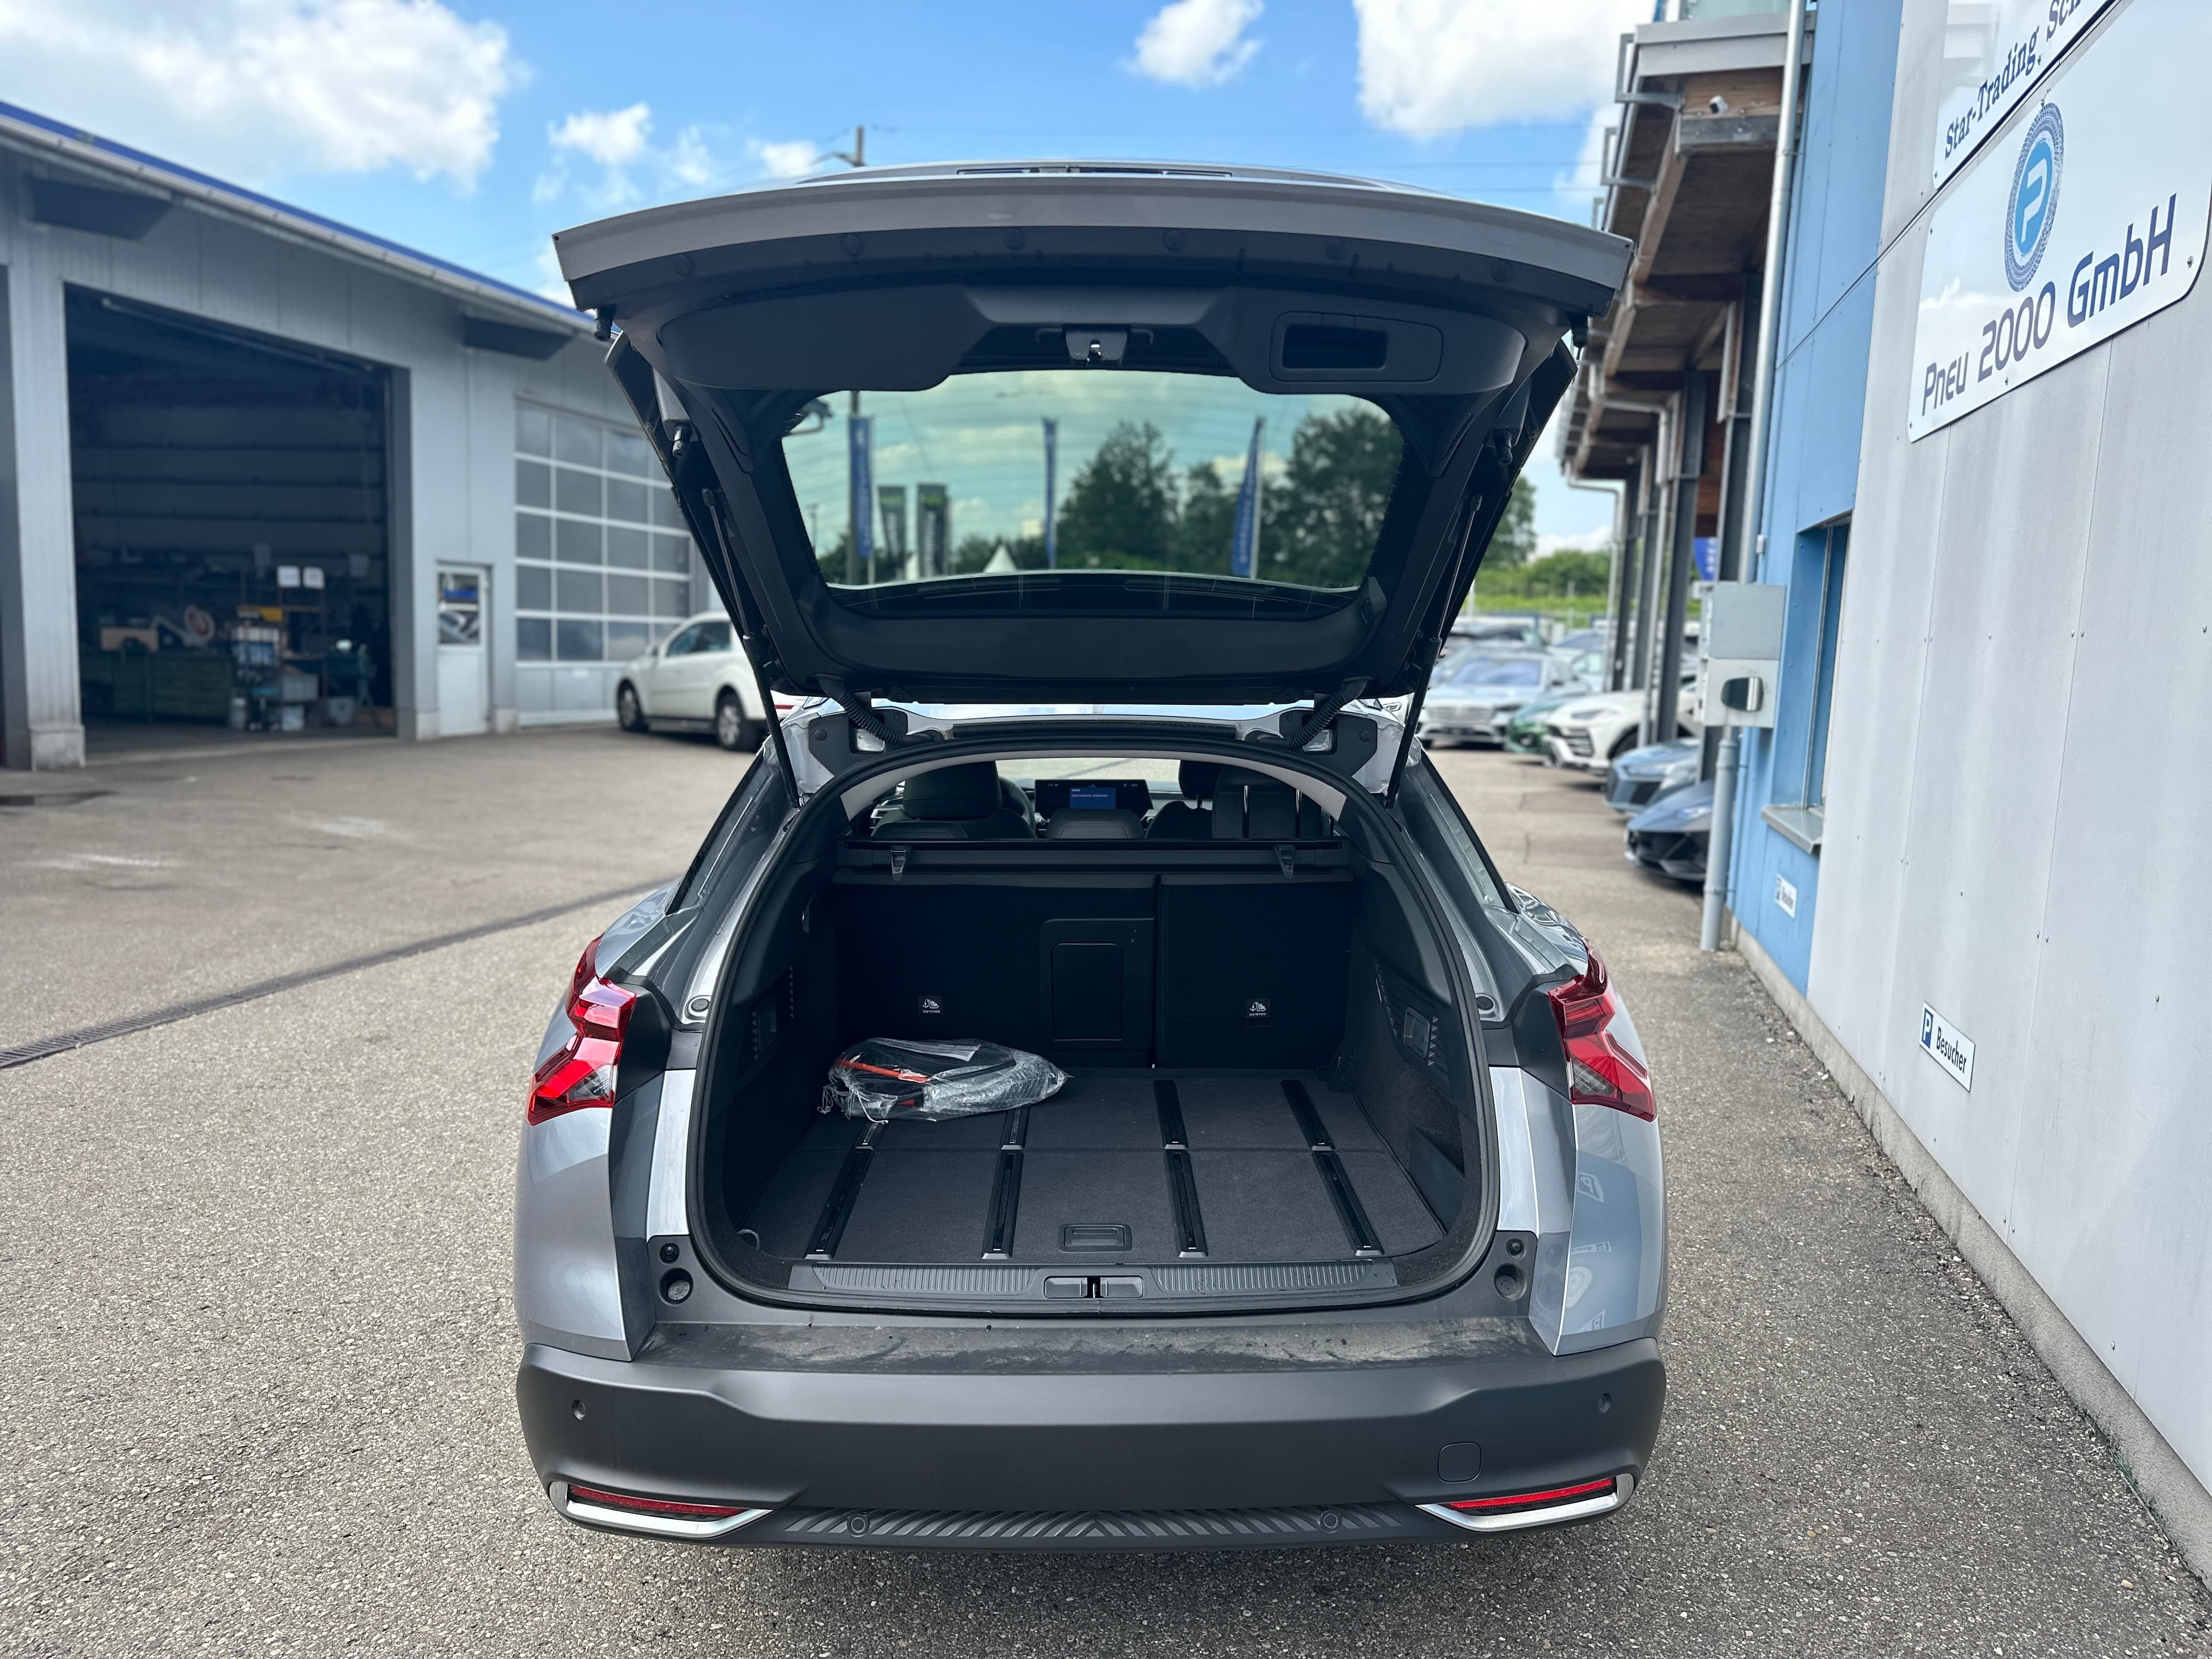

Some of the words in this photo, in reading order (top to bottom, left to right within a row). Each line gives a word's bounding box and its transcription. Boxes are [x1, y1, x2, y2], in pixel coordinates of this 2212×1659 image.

[1922, 351, 1969, 417] Pneu
[1977, 280, 2056, 383] 2000
[2067, 193, 2177, 329] GmbH
[1923, 1011, 1932, 1042] P
[1936, 1026, 1967, 1074] Besucher
